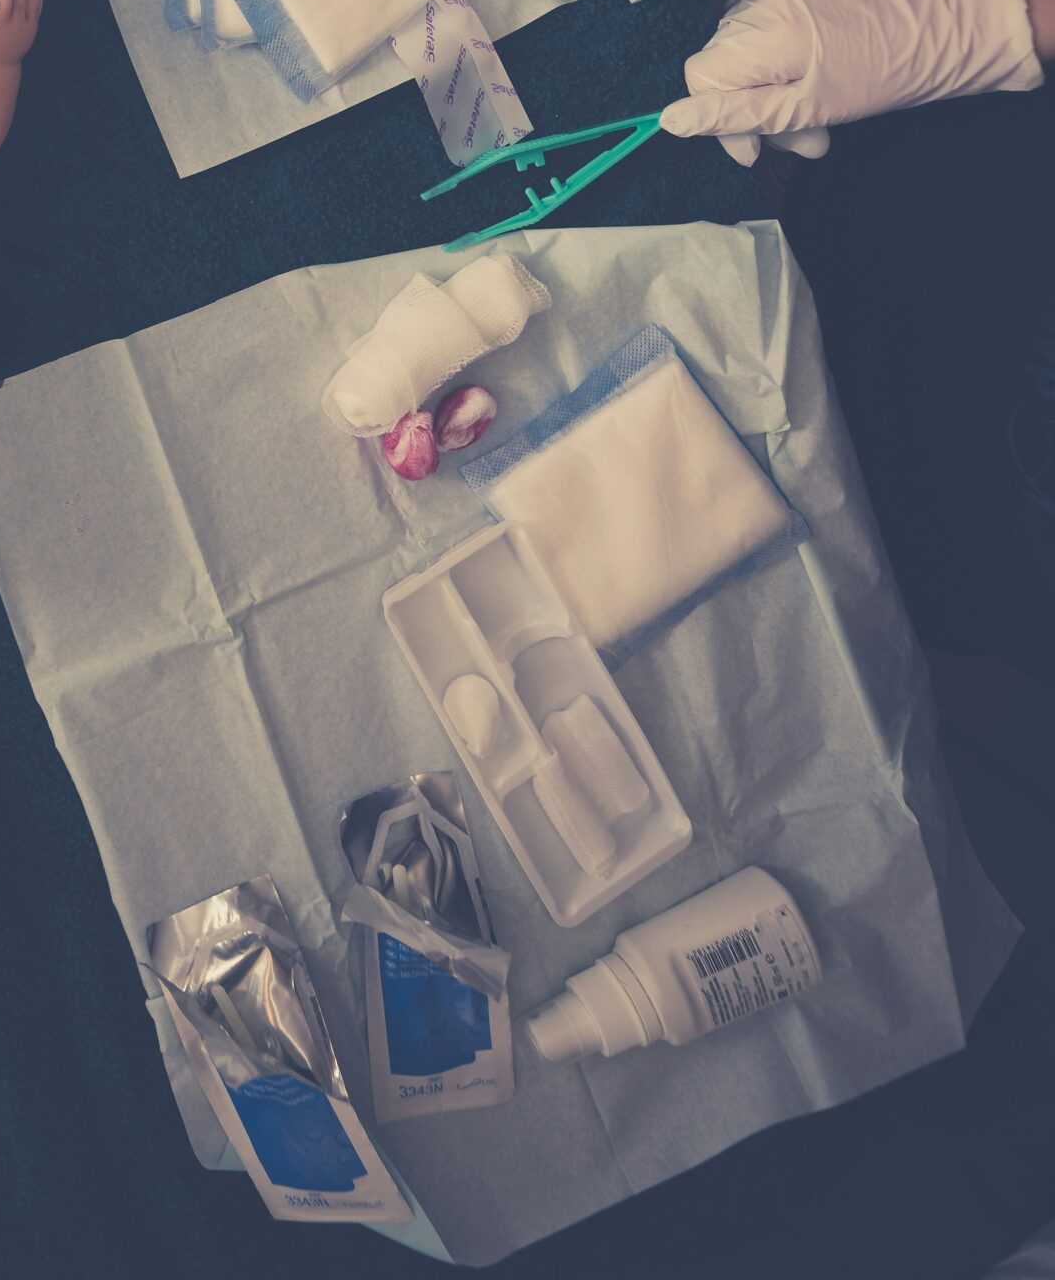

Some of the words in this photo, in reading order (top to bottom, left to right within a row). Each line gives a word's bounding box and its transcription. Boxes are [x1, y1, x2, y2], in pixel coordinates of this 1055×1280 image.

[423, 3, 435, 63] Safetac
[443, 44, 467, 106] Safetac
[462, 88, 485, 149] Safetac
[399, 1083, 443, 1098] 3343N
